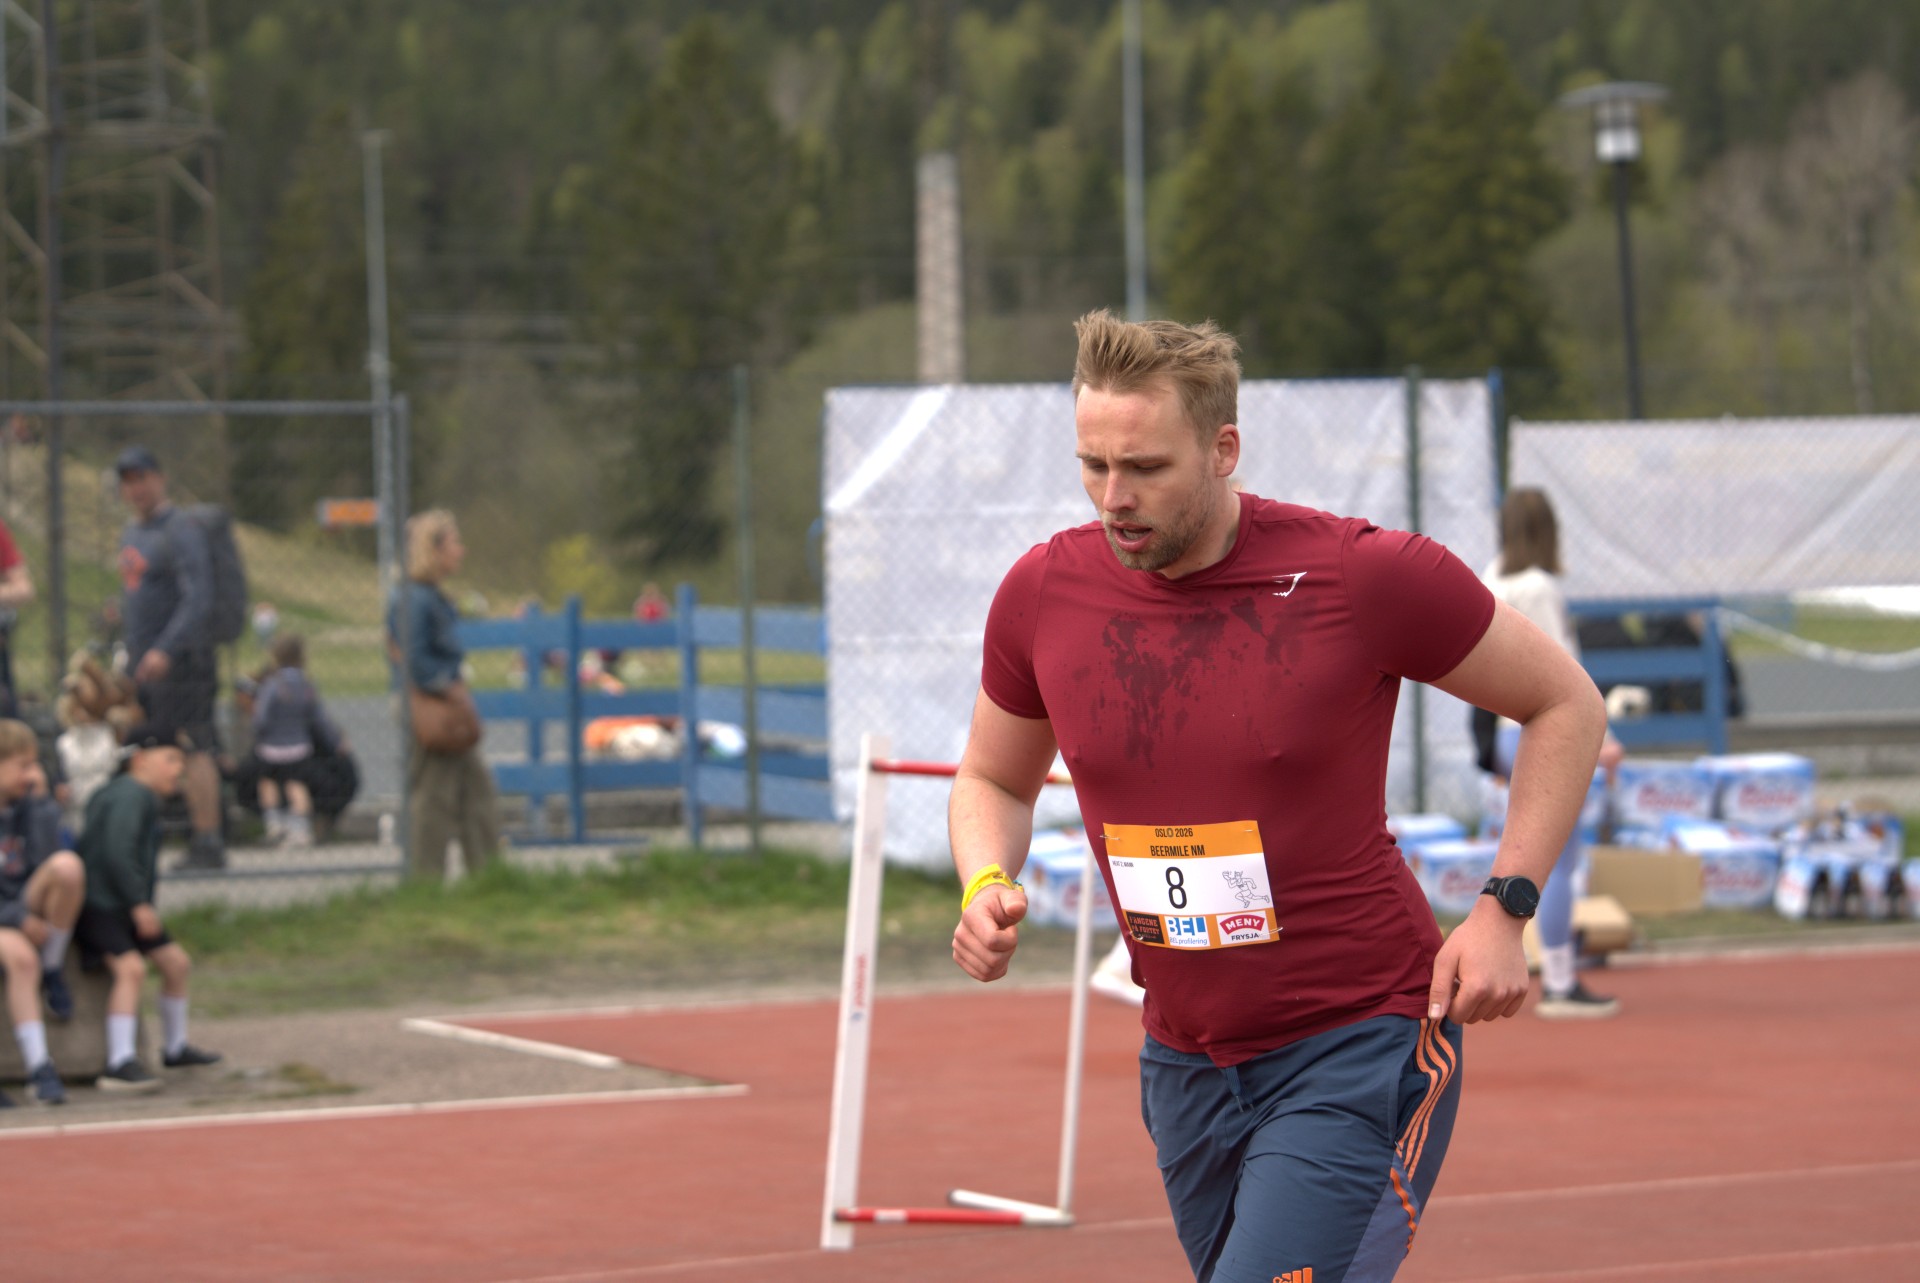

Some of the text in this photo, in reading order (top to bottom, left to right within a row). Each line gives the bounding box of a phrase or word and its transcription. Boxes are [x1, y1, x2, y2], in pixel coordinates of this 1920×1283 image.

[1154, 827, 1194, 838] OSLO 2026
[1150, 844, 1206, 857] BEERMILE NM
[1165, 866, 1188, 910] 8
[1166, 916, 1207, 936] BEL
[1225, 917, 1261, 931] MENY
[1178, 937, 1208, 946] profilering
[1231, 932, 1260, 941] FRYSJA
